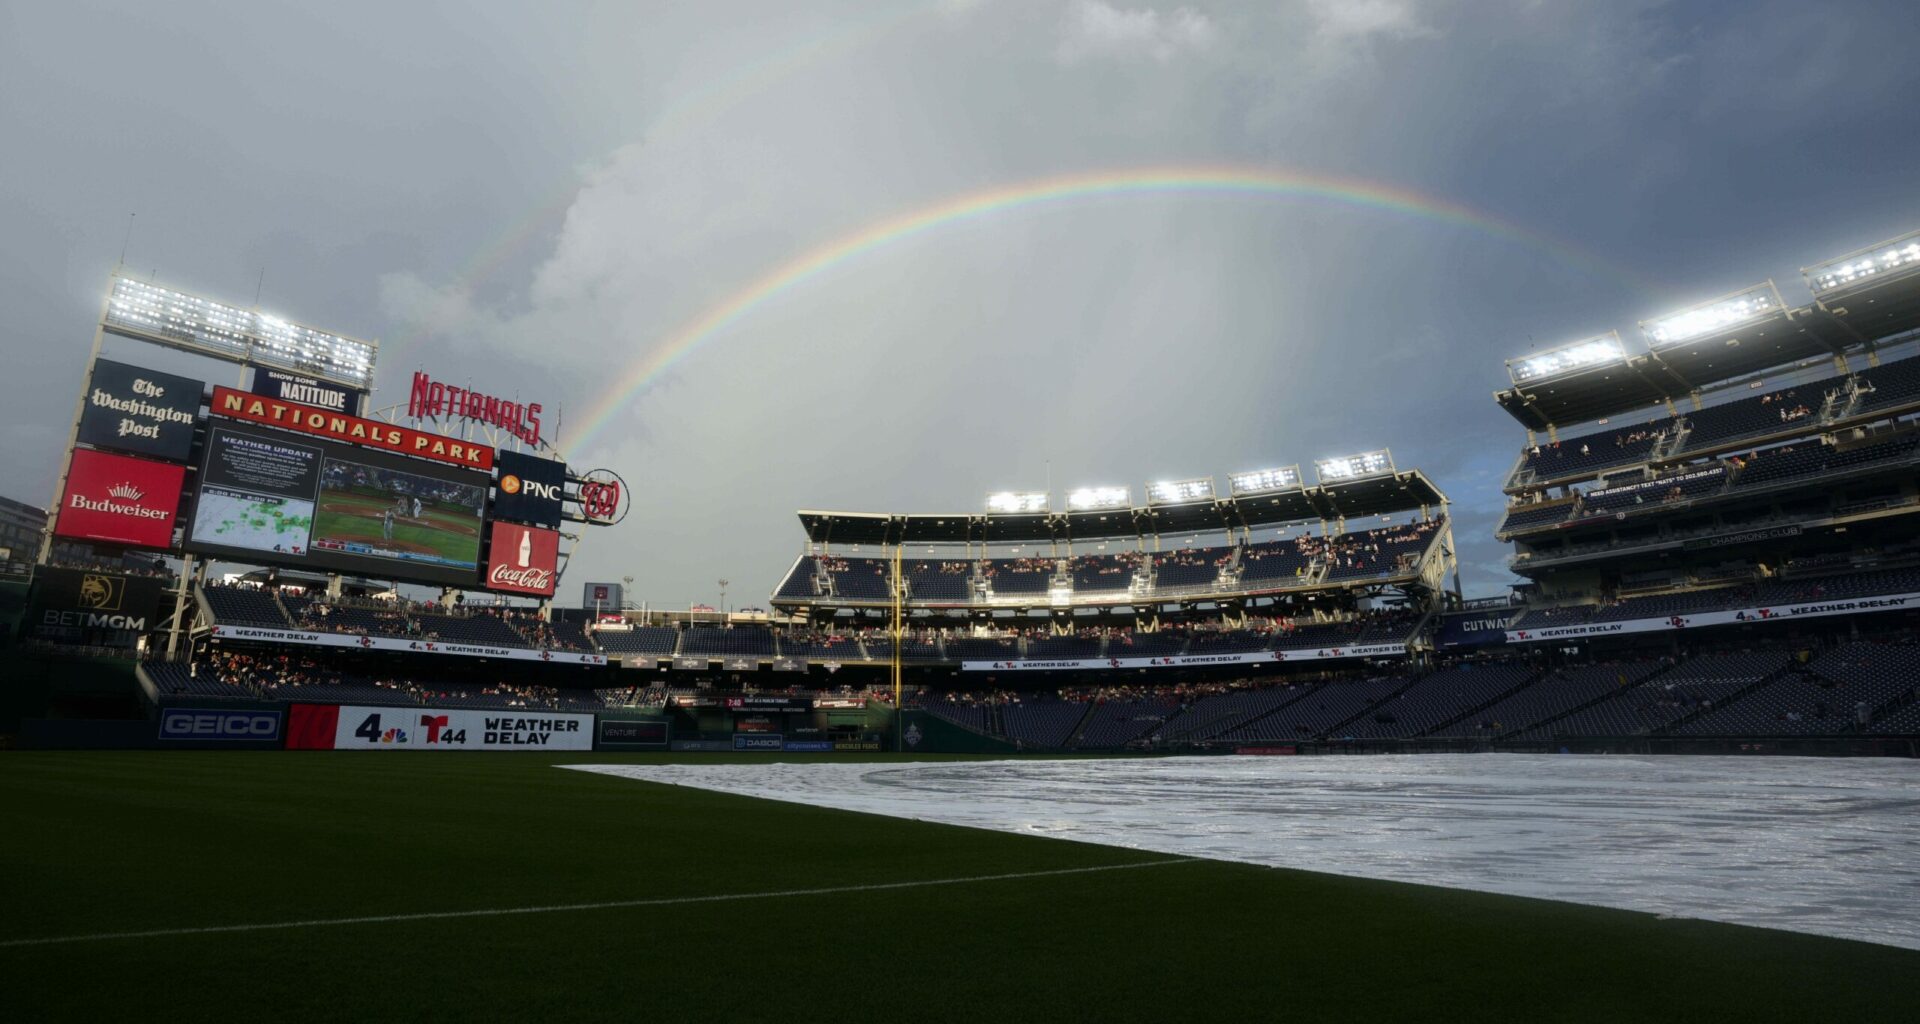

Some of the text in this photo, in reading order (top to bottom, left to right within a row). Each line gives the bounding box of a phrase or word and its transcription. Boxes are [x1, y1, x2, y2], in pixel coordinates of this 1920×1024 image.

[132, 378, 165, 398] The
[268, 371, 318, 386] SHOW SOME
[280, 381, 346, 409] NATITUDE
[92, 387, 193, 425] Washington
[408, 371, 543, 445] NATIONALS
[118, 418, 161, 439] Post
[224, 394, 482, 463] NATIONALS PARK
[222, 436, 272, 451] WEATHER
[273, 446, 314, 459] UPDATE
[522, 480, 561, 501] PNC
[70, 494, 169, 520] Budweiser
[1770, 527, 1798, 537] CLUB
[1790, 603, 1856, 615] WEATHER
[1859, 598, 1906, 608] DELAY
[43, 609, 146, 631] BETMGM
[235, 629, 285, 639] WEATHER
[287, 632, 320, 641] DELAY
[1540, 627, 1588, 638] WEATHER
[1589, 624, 1623, 633] DELAY
[446, 645, 483, 653] WEATHER
[485, 648, 510, 656] DELAY
[1351, 646, 1391, 654] WEATHER
[164, 714, 277, 735] GEICO
[355, 713, 382, 743] 4
[484, 718, 580, 732] WEATHER
[604, 728, 638, 737] VENTURE
[483, 732, 551, 745] DELAY
